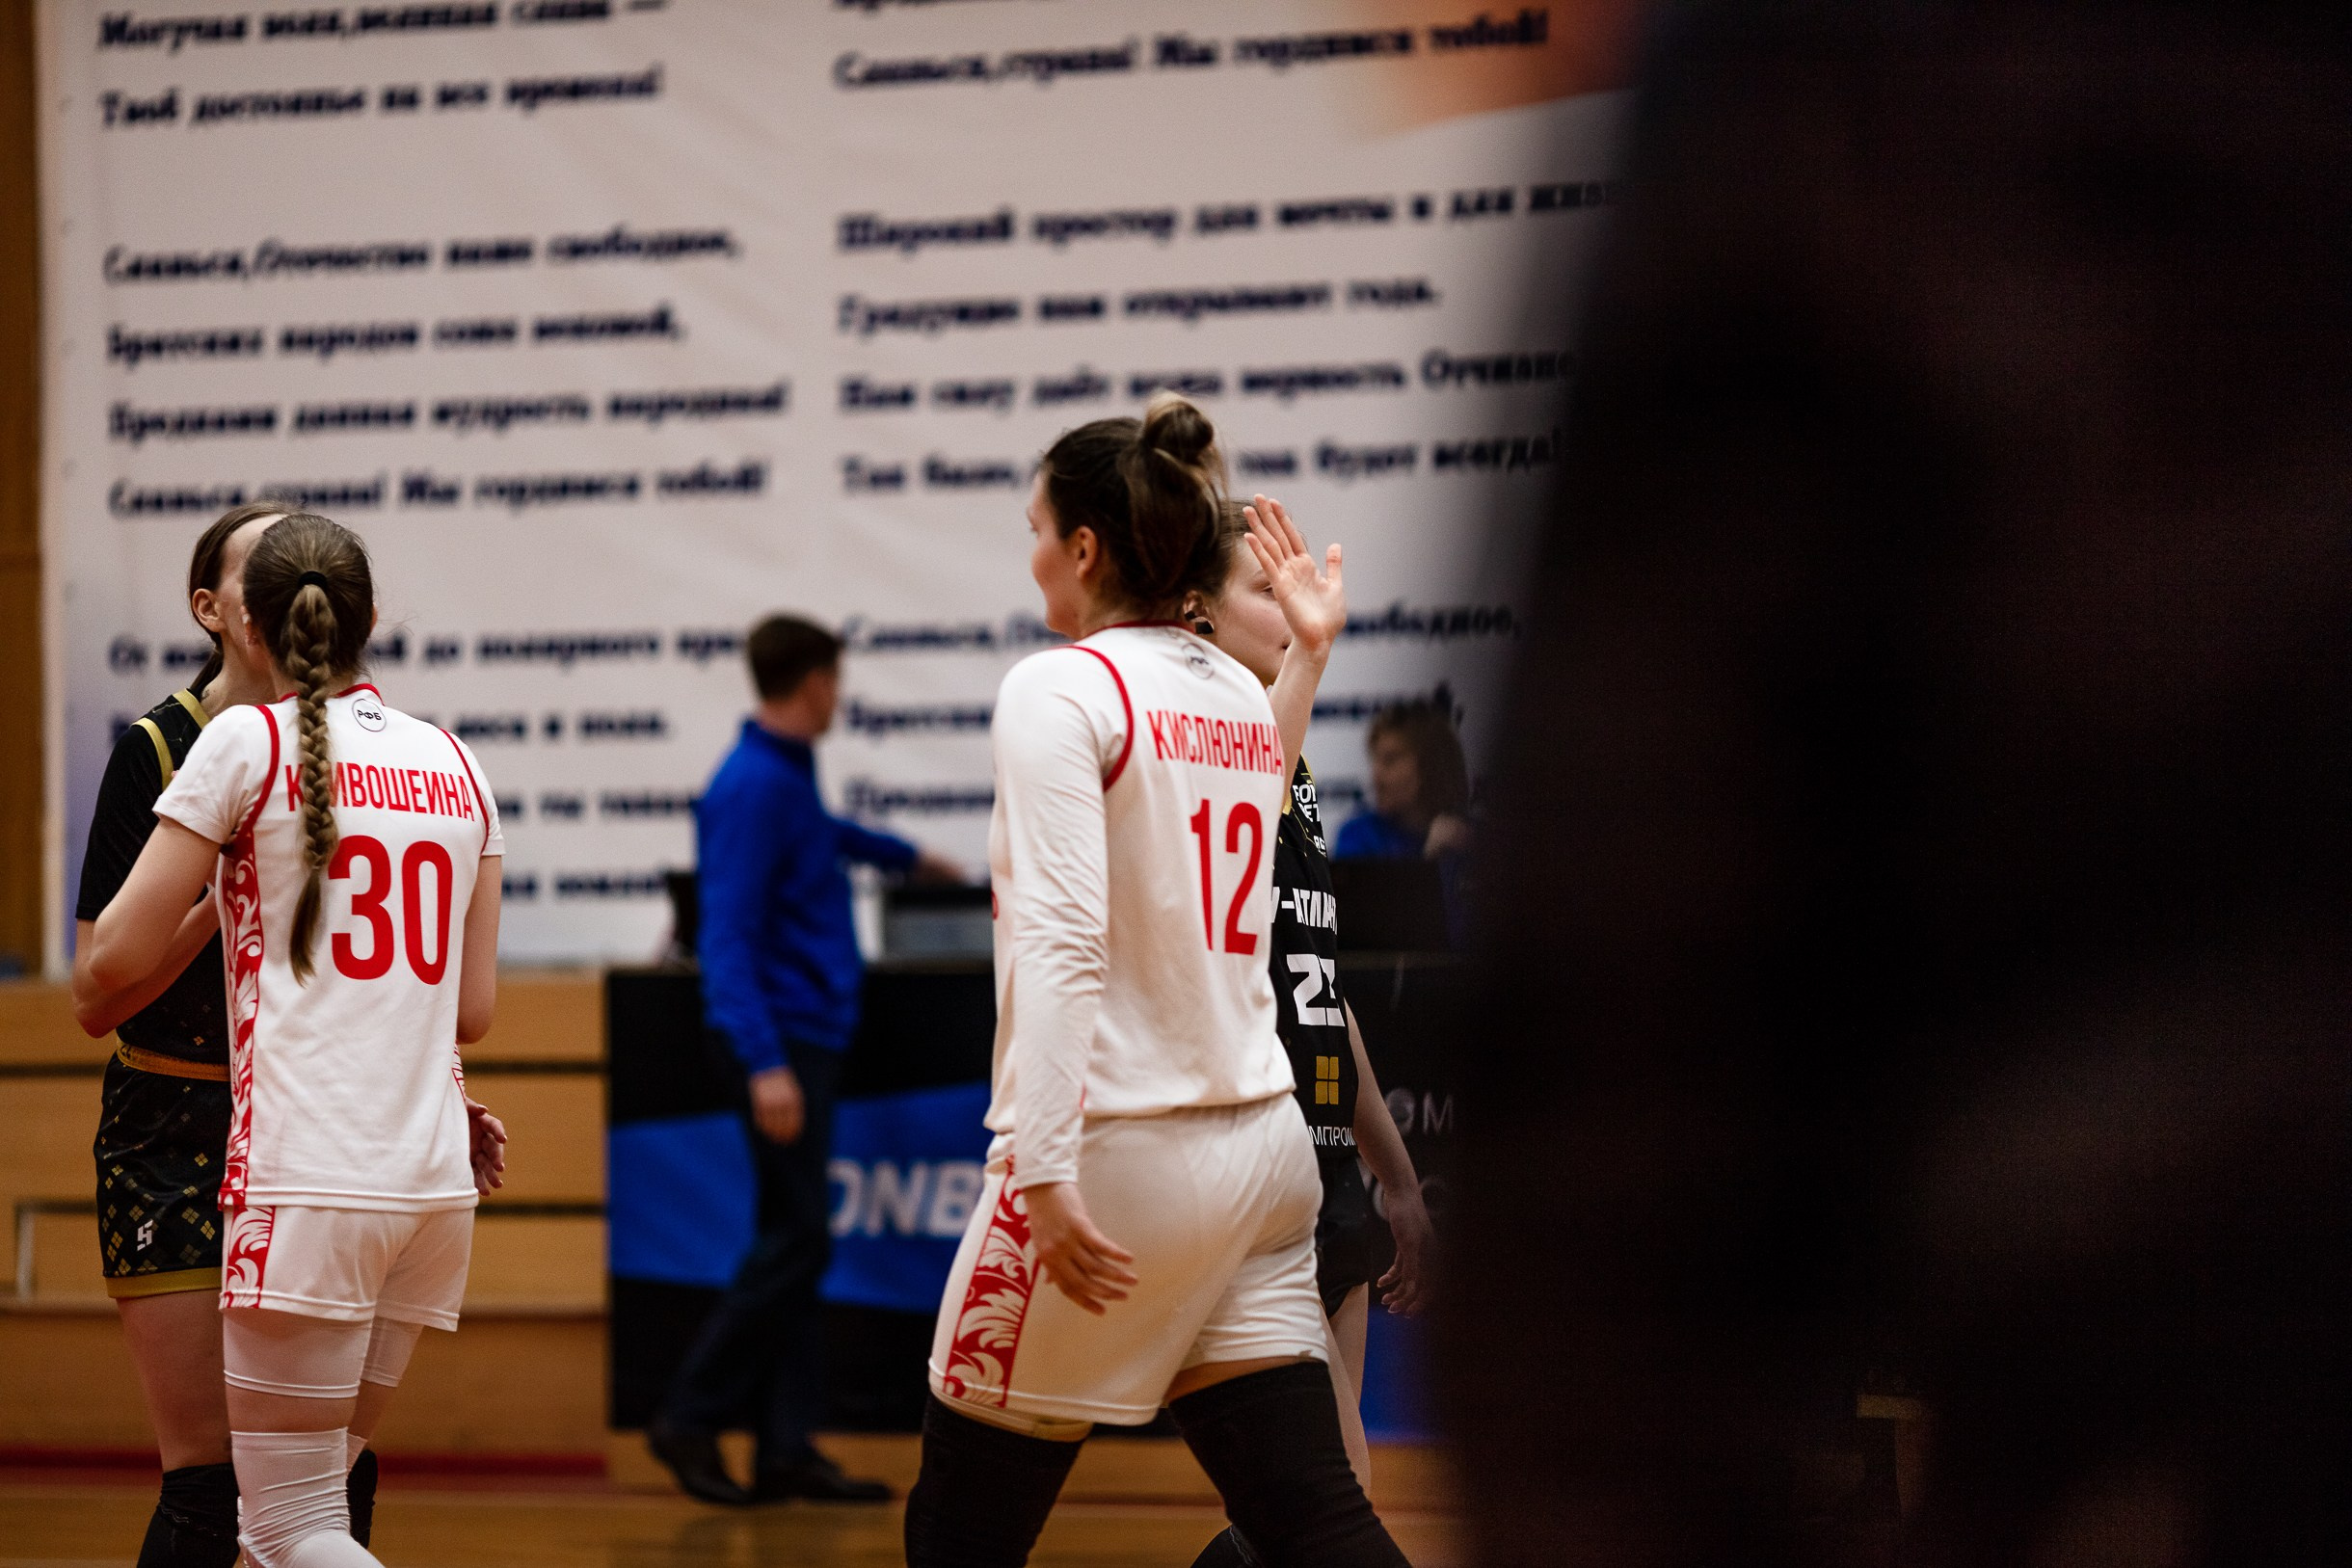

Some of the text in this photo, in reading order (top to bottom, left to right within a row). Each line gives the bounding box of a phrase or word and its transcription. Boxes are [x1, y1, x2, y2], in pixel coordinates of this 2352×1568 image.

[356, 708, 382, 721] РФБ
[1147, 710, 1284, 776] КИСЛЮНИНА
[285, 761, 475, 821] КИВОШЕИНА
[1190, 798, 1263, 956] 12
[328, 835, 453, 986] 30
